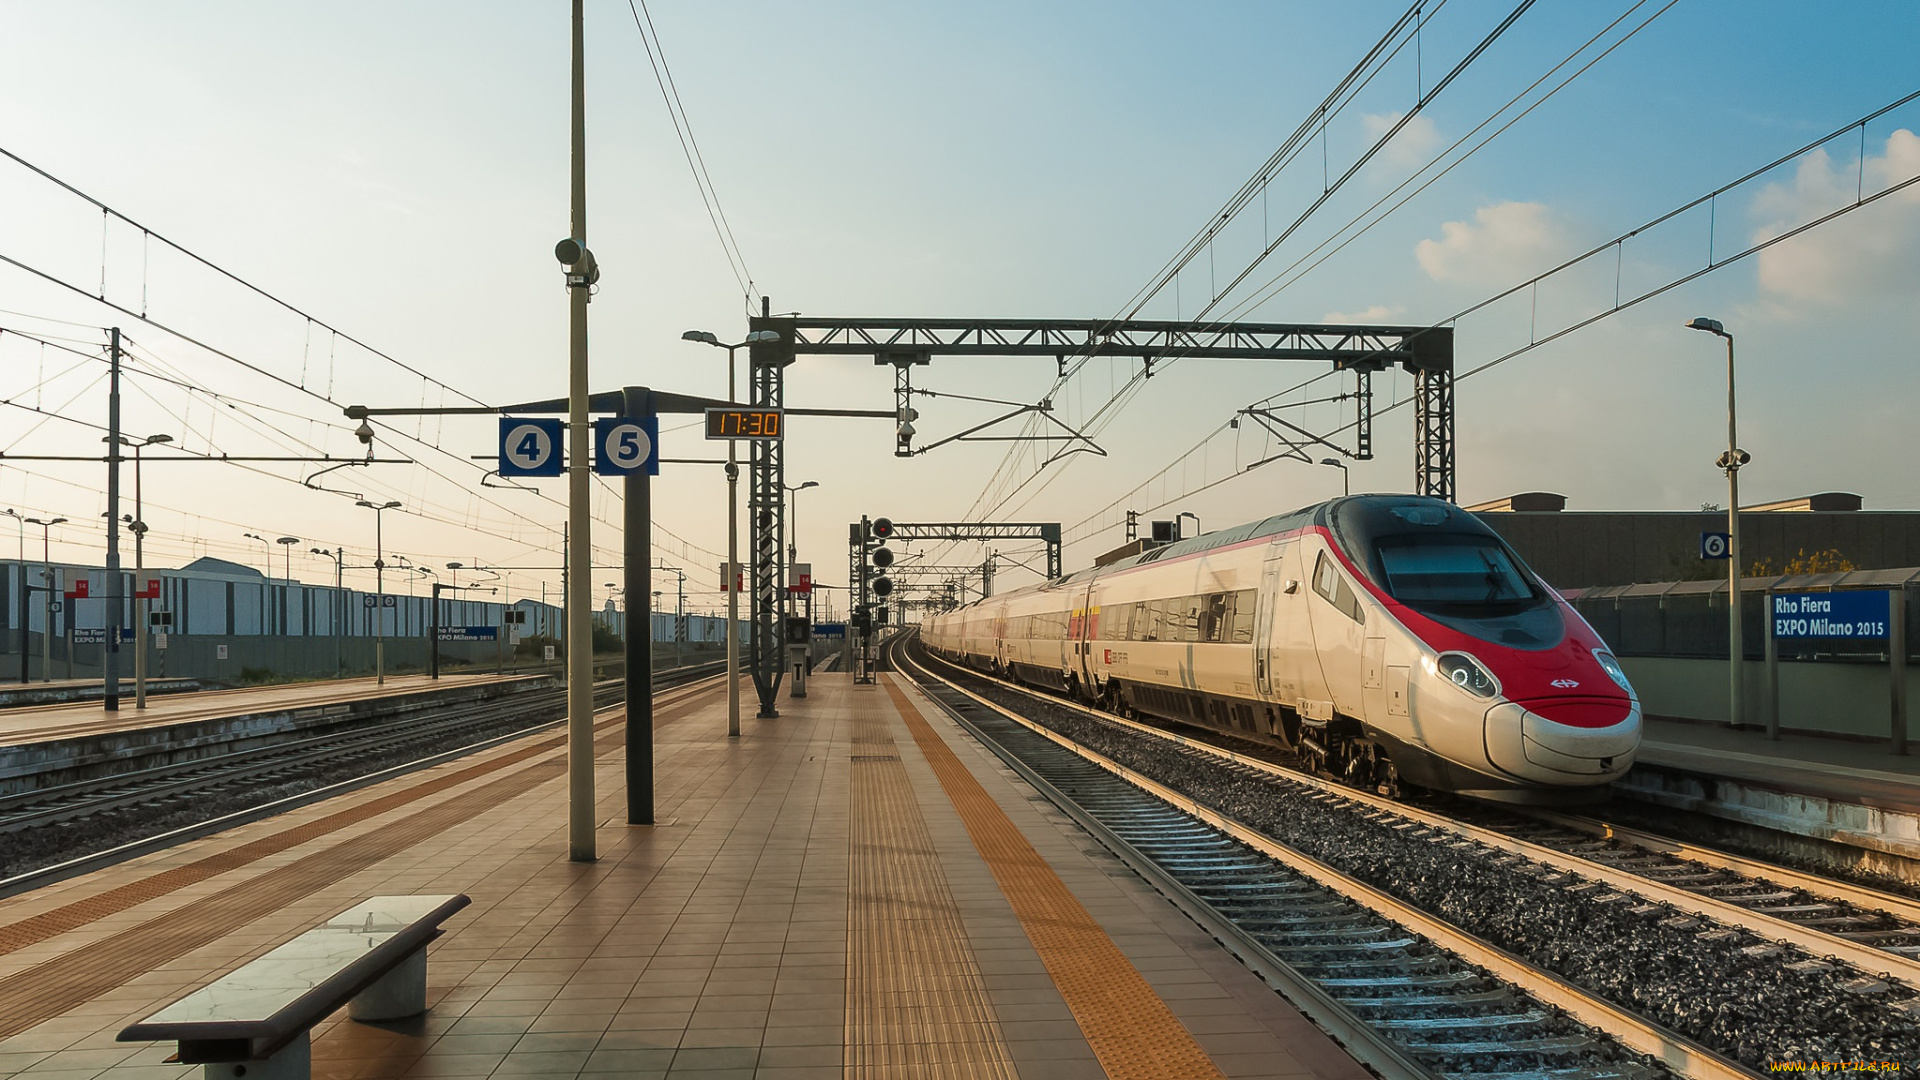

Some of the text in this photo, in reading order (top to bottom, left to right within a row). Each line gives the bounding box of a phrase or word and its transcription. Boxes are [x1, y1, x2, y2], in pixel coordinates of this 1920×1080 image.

[719, 413, 779, 436] 17:30
[515, 432, 541, 461] 4
[617, 432, 640, 461] 5
[1709, 538, 1720, 553] 6
[1776, 597, 1831, 613] Rho Fiera
[1776, 619, 1884, 636] EXPO Milano 2015
